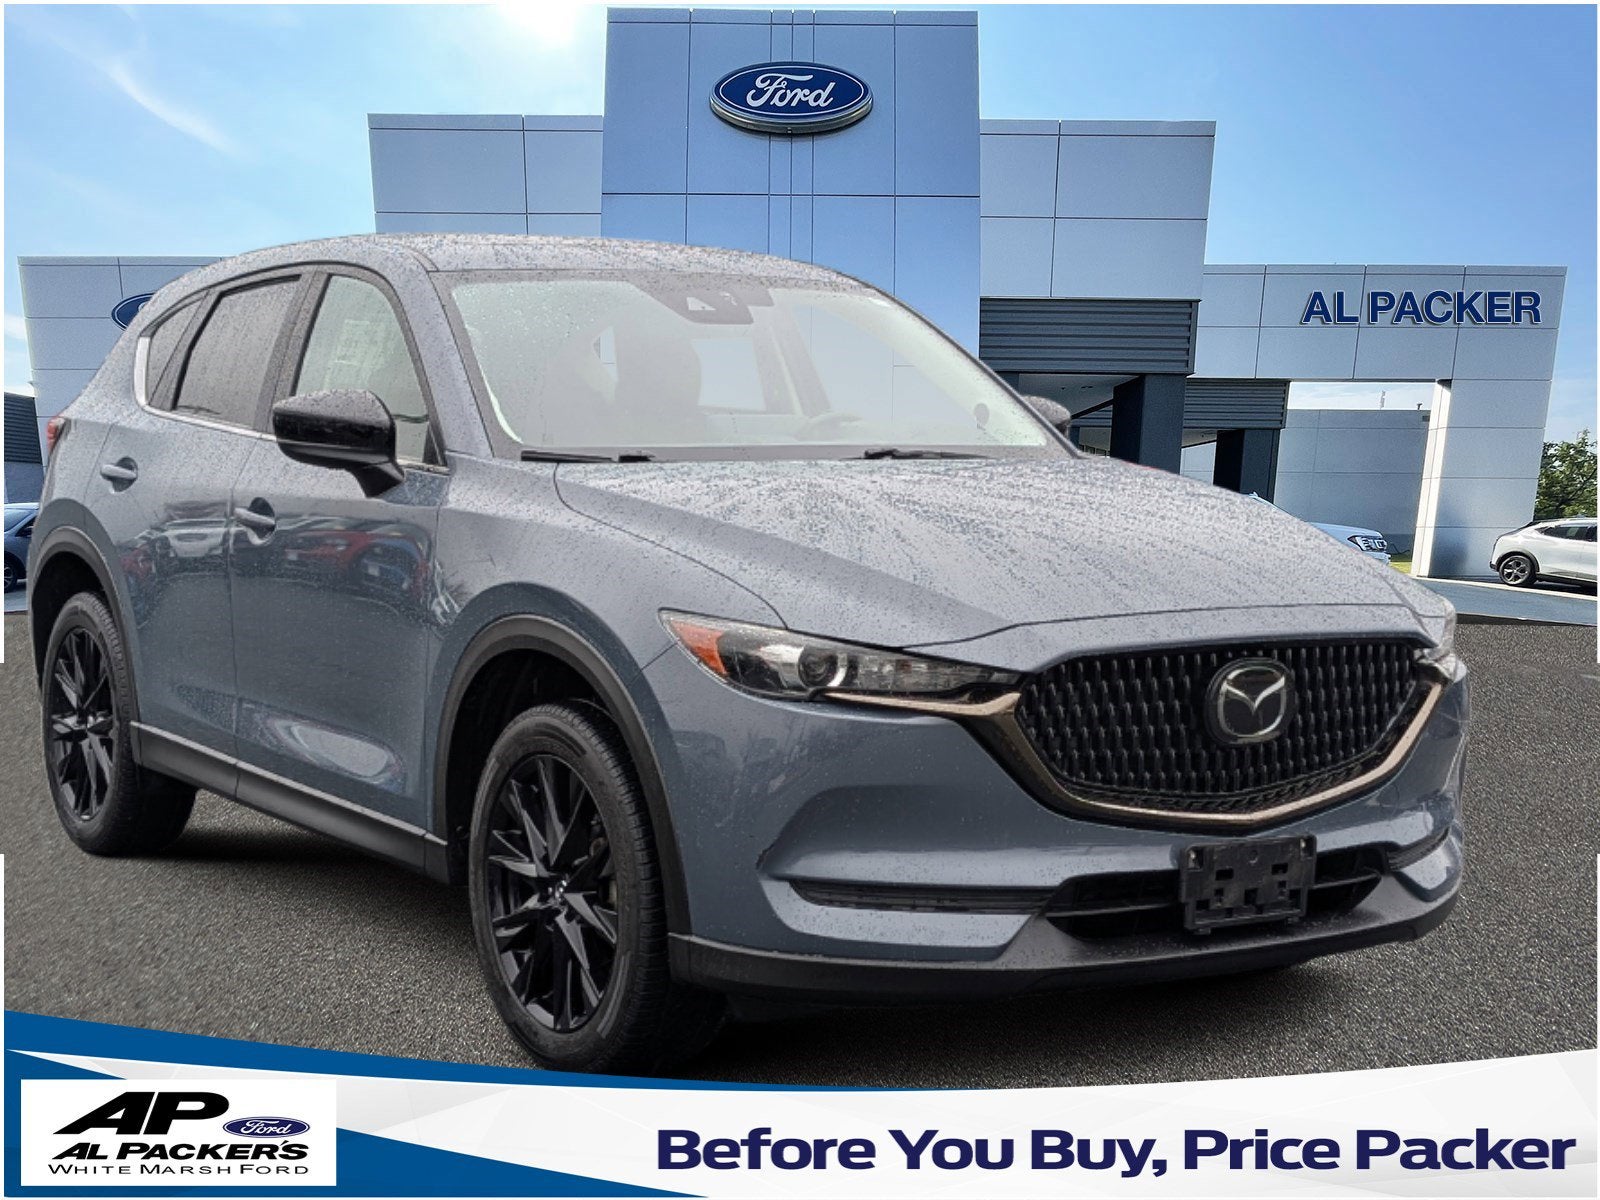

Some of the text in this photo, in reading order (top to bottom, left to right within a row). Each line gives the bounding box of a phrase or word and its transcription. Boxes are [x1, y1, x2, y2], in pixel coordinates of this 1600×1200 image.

[746, 73, 836, 107] Ford
[1302, 290, 1542, 324] AL PACKER
